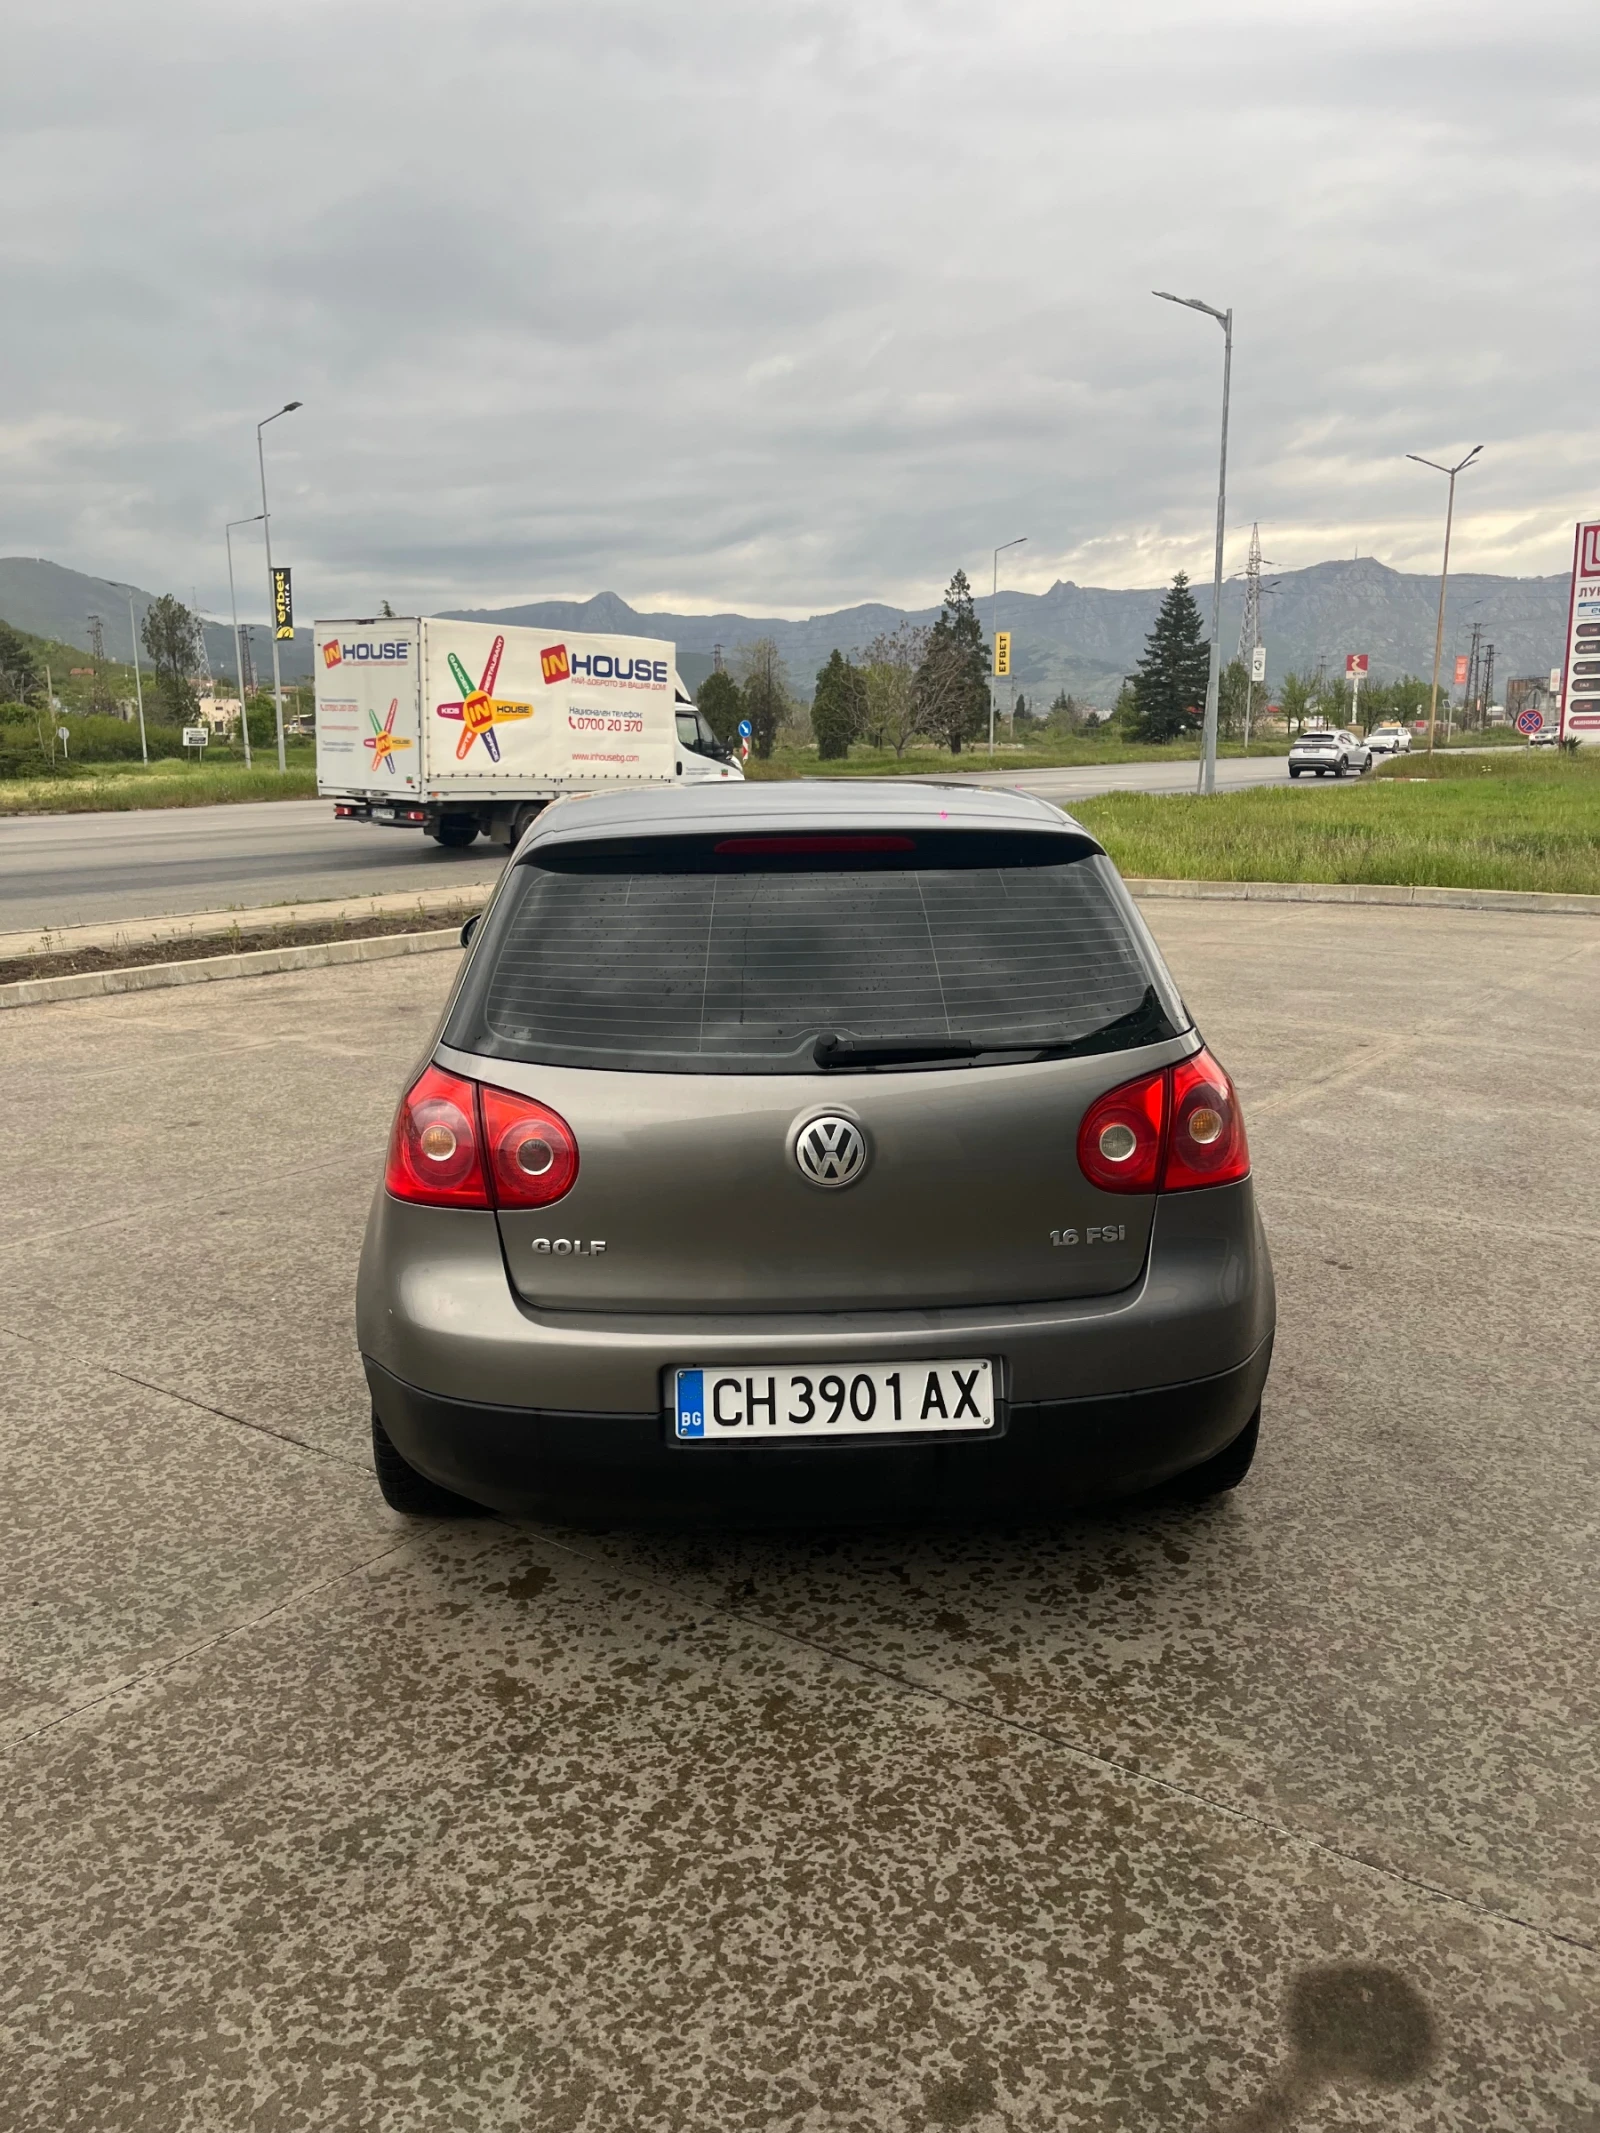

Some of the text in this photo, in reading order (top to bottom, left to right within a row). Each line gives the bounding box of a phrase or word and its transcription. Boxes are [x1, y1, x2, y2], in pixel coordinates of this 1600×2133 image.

[275, 571, 286, 623] efbet
[324, 643, 408, 664] IN HOUSE
[999, 635, 1007, 672] EFBET
[448, 654, 471, 694] GARDEN
[484, 637, 503, 692] RESTAURANT
[542, 652, 668, 682] IN HOUSE
[441, 707, 460, 715] KIDS
[469, 701, 530, 722] IN HOUSE
[568, 706, 611, 717] Национален
[577, 717, 643, 732] 0700 20 370
[572, 753, 640, 763] www.inhousebg.com
[531, 1238, 606, 1256] GOLF
[681, 1411, 701, 1427] BG
